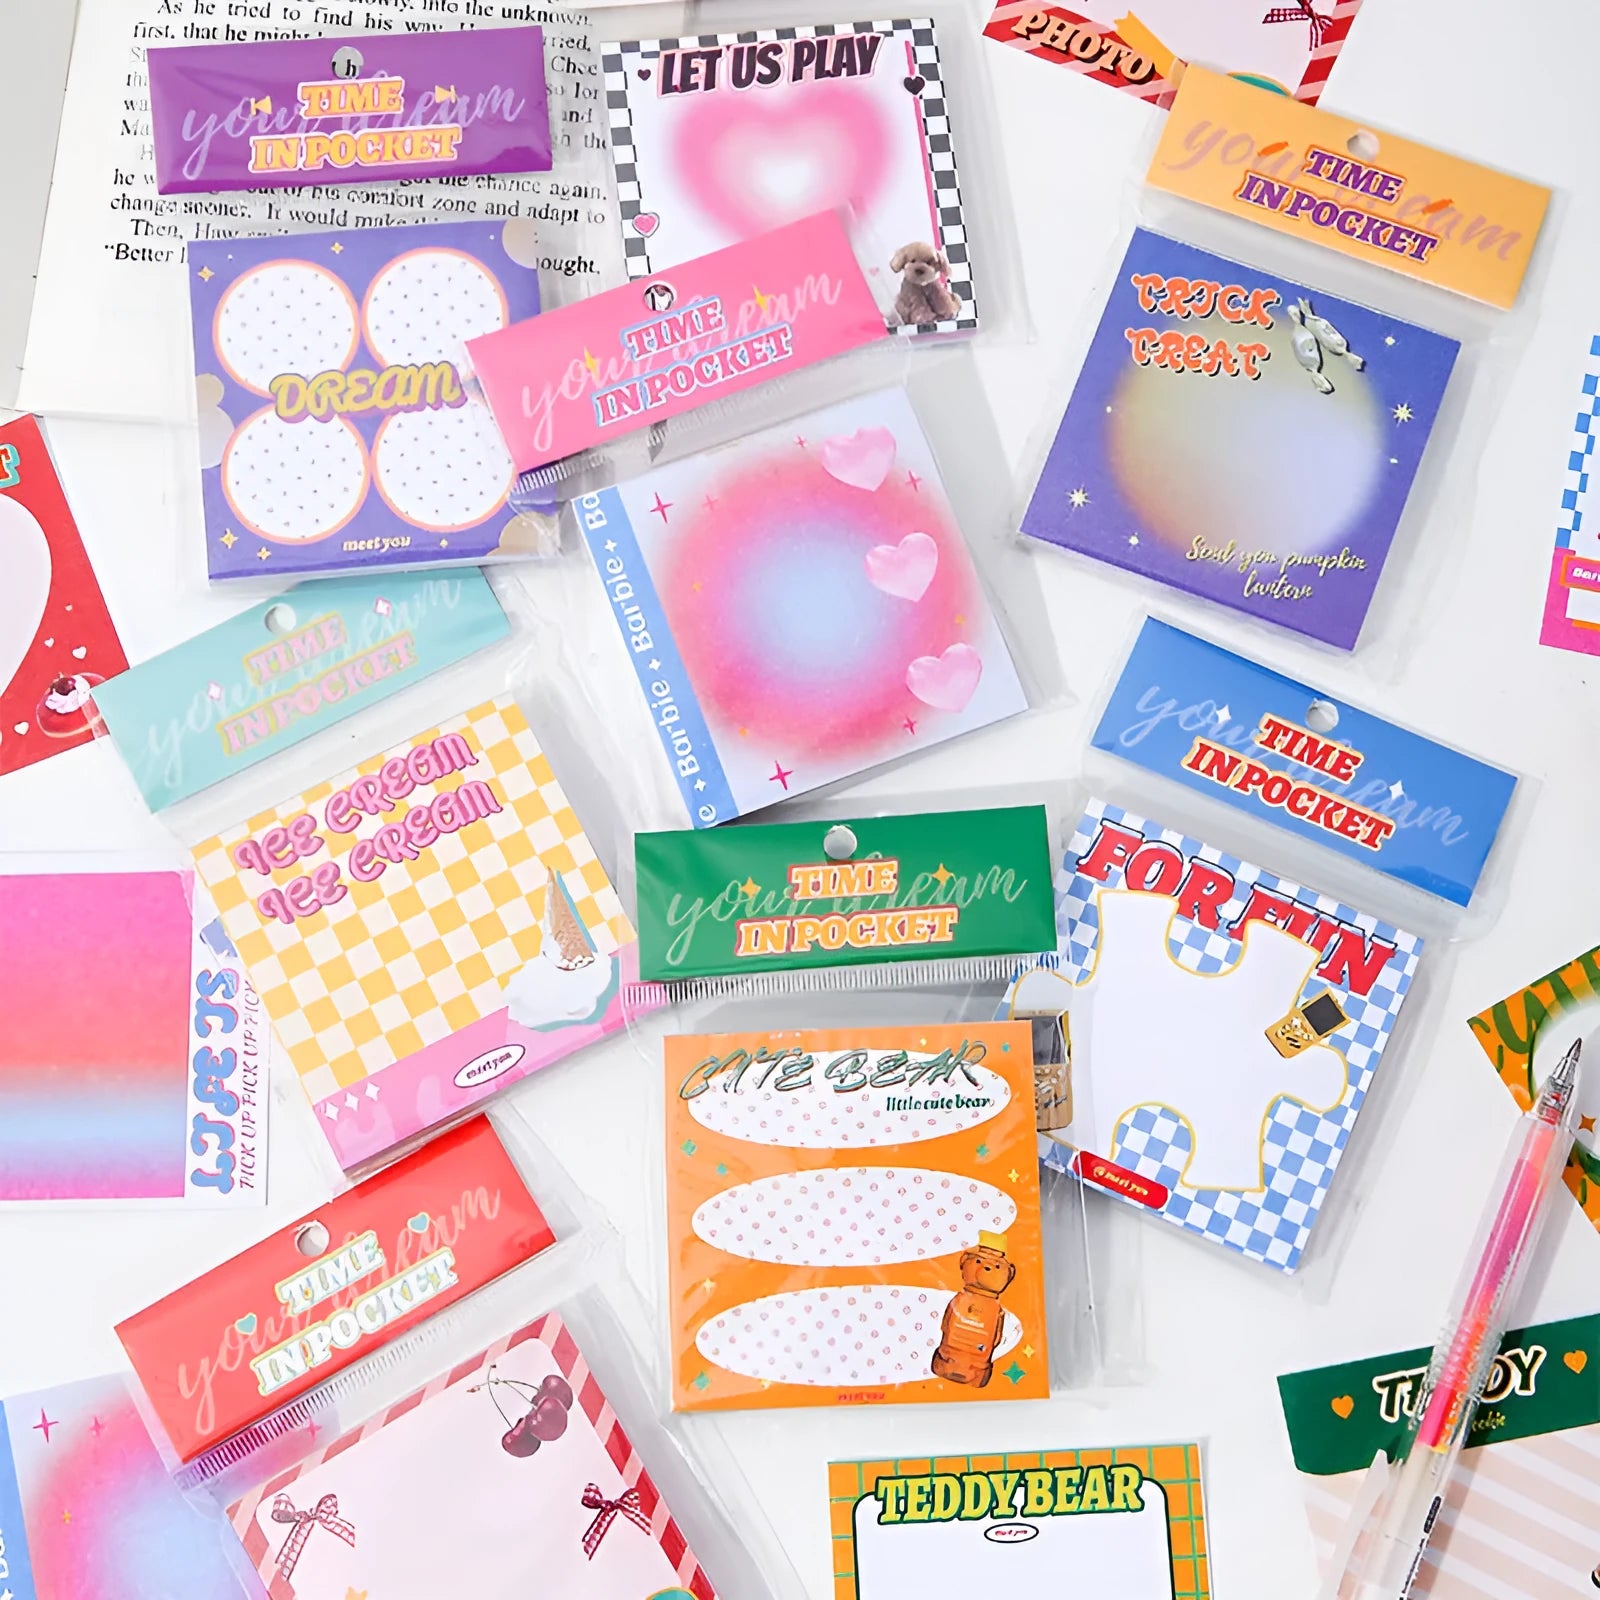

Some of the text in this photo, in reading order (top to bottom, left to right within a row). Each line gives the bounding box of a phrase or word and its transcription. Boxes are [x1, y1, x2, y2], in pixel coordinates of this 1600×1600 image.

[157, 0, 183, 15] As
[194, 0, 216, 15] he
[228, 1, 271, 19] tried
[283, 7, 301, 21] to
[313, 7, 354, 27] find
[365, 12, 393, 31] his
[183, 22, 219, 40] that
[225, 24, 247, 42] he
[465, 0, 495, 18] the
[659, 33, 883, 96] LET US PLAY
[1011, 9, 1157, 86] PHOTO
[300, 79, 404, 117] TIME
[251, 127, 461, 171] IN POCKET
[1306, 149, 1406, 203] TIME
[113, 168, 135, 186] he
[549, 182, 607, 201] again.
[432, 196, 478, 214] zone
[484, 200, 520, 217] and
[527, 202, 580, 226] adapt
[587, 207, 606, 224] to
[130, 218, 184, 240] Then,
[266, 202, 281, 220] It
[289, 207, 348, 228] would
[1238, 174, 1438, 264] IN POCKET
[625, 300, 726, 360] TIME
[1131, 272, 1281, 329] TRICK
[594, 325, 793, 426] IN POCKET
[1125, 327, 1272, 380] TREAT
[269, 361, 468, 424] DREAM
[1243, 569, 1314, 600] lantern
[1280, 546, 1368, 578] pumpkin
[605, 556, 654, 654] Barbie
[247, 613, 348, 685] TIME
[220, 633, 418, 756] IN POCKET
[650, 679, 701, 778] Barbie
[1259, 716, 1363, 784] TIME
[233, 732, 479, 876] ICE CREAM
[1186, 740, 1397, 852] IN POCKET
[257, 780, 504, 925] ICE CREAM
[791, 859, 898, 901] TIME
[1076, 817, 1236, 932] FOR
[738, 906, 959, 957] IN POCKET
[242, 1029, 259, 1057] UP
[679, 1040, 988, 1100] CUTE BEAR
[190, 967, 241, 1195] LIFE IS
[241, 1061, 259, 1107] PICK
[240, 1110, 257, 1139] UP
[279, 1232, 387, 1316] TIME
[252, 1248, 460, 1396] IN POCKET
[1372, 1345, 1547, 1424] TEDY
[876, 1463, 1145, 1525] TEDDY BEAR
